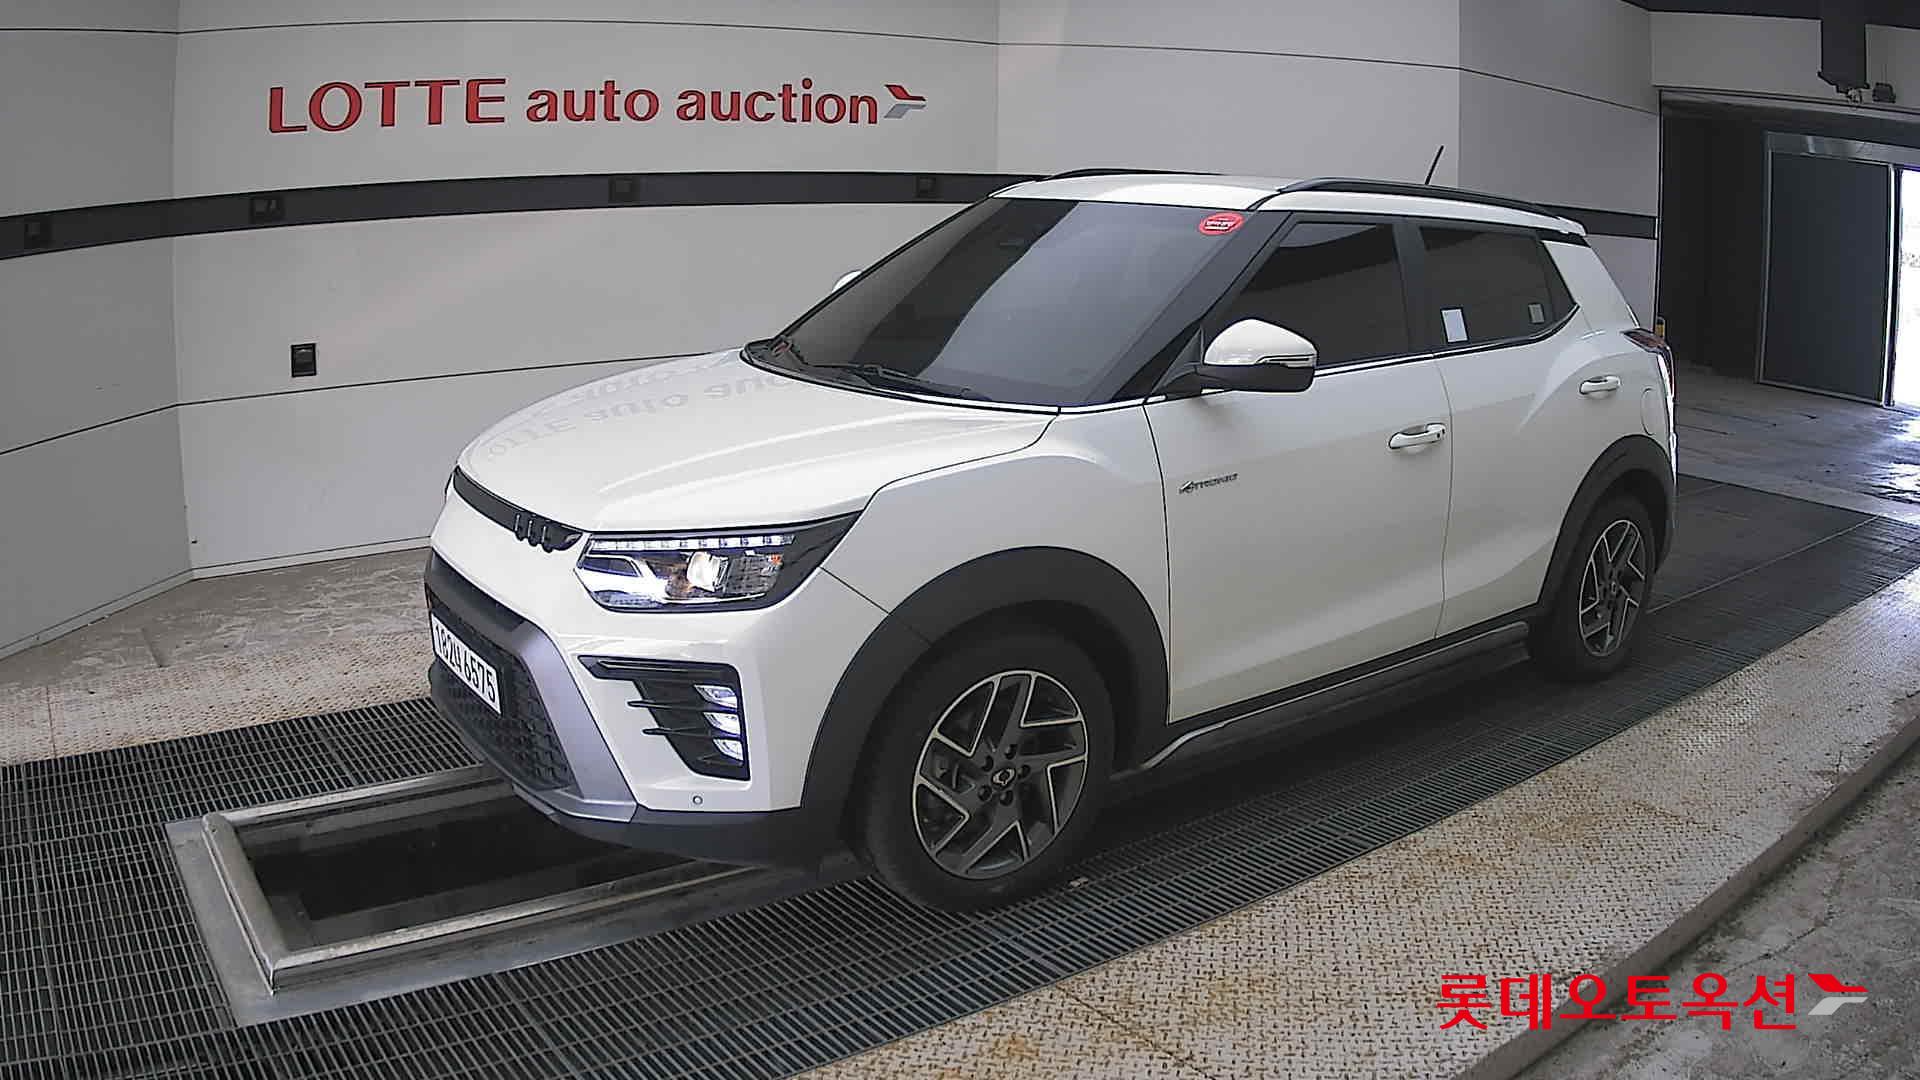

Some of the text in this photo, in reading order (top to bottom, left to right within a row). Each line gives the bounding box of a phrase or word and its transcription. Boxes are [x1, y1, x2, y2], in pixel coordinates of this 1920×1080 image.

[268, 78, 878, 133] LOTTE auto auction
[464, 650, 496, 703] 6575
